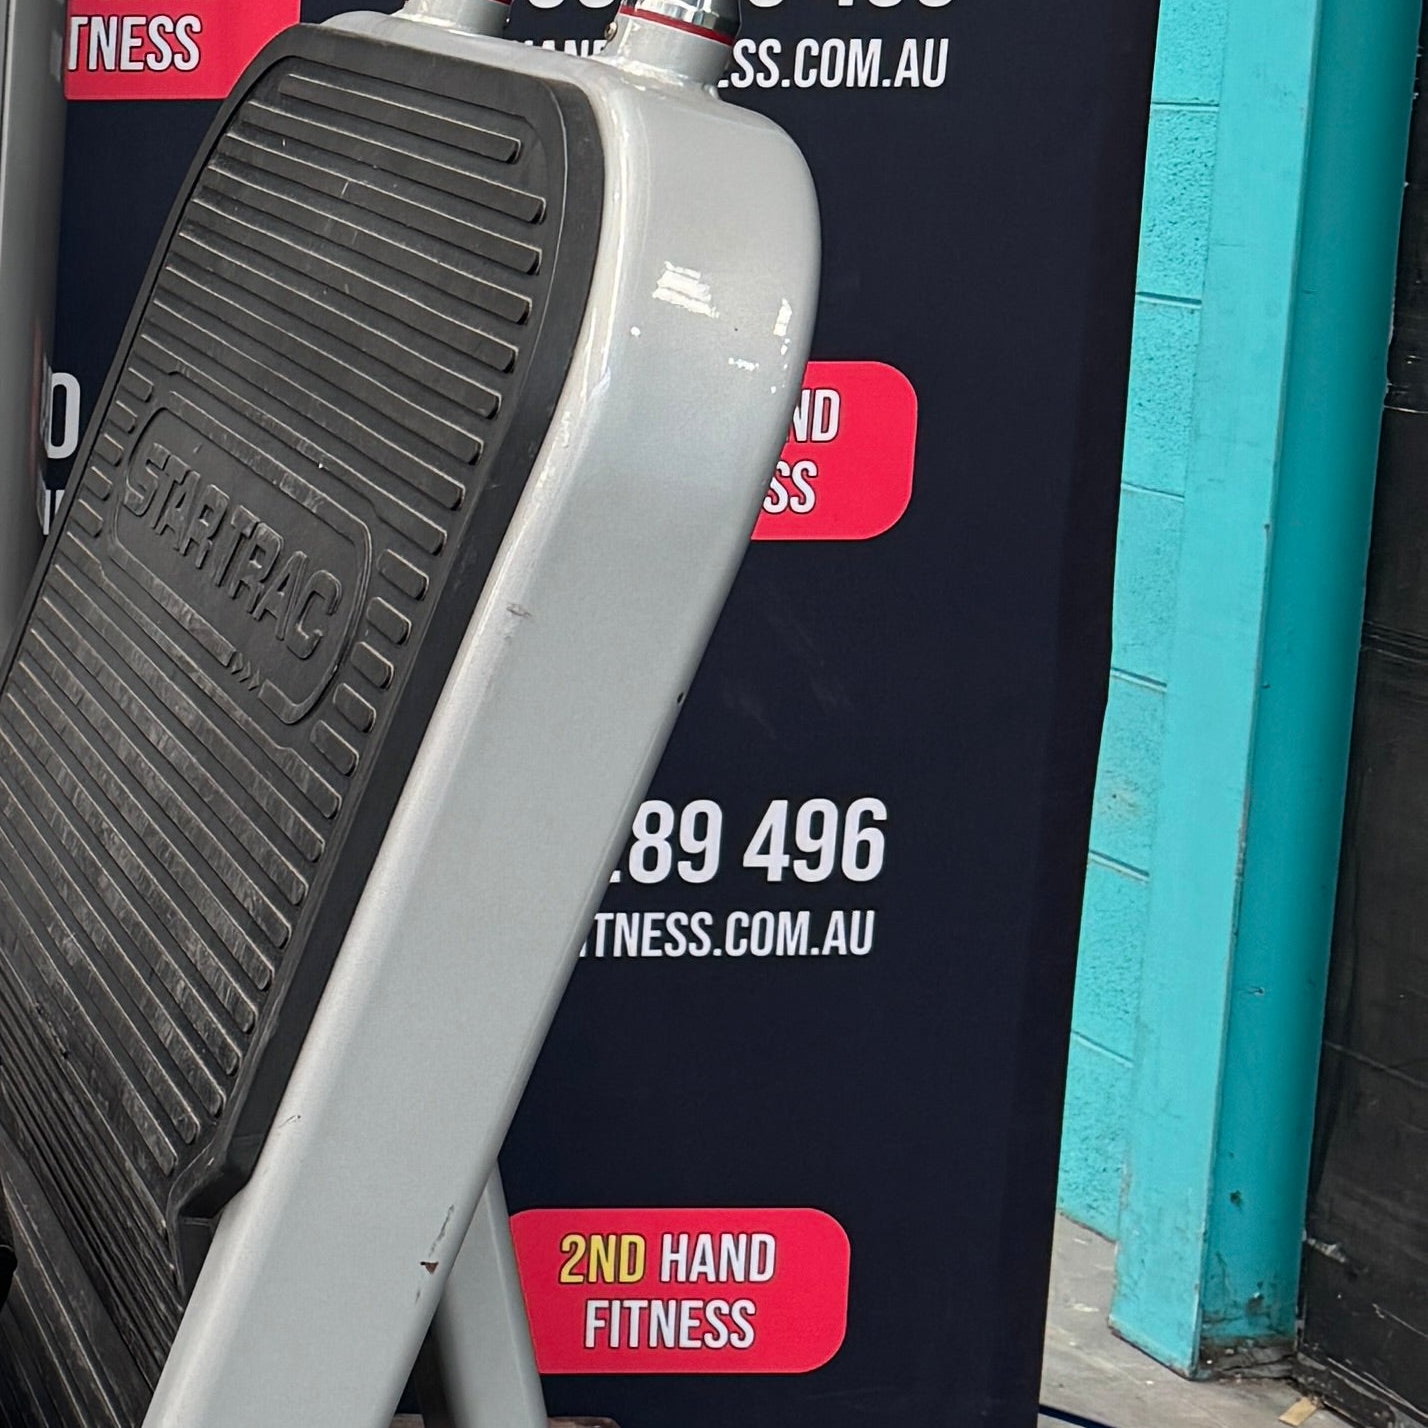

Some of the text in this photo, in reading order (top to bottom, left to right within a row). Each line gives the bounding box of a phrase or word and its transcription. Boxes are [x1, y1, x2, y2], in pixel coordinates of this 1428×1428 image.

[68, 15, 201, 71] TNESS
[608, 797, 888, 884] 89 496
[560, 1233, 776, 1283] 2ND HAND
[585, 1299, 756, 1348] FITNESS
